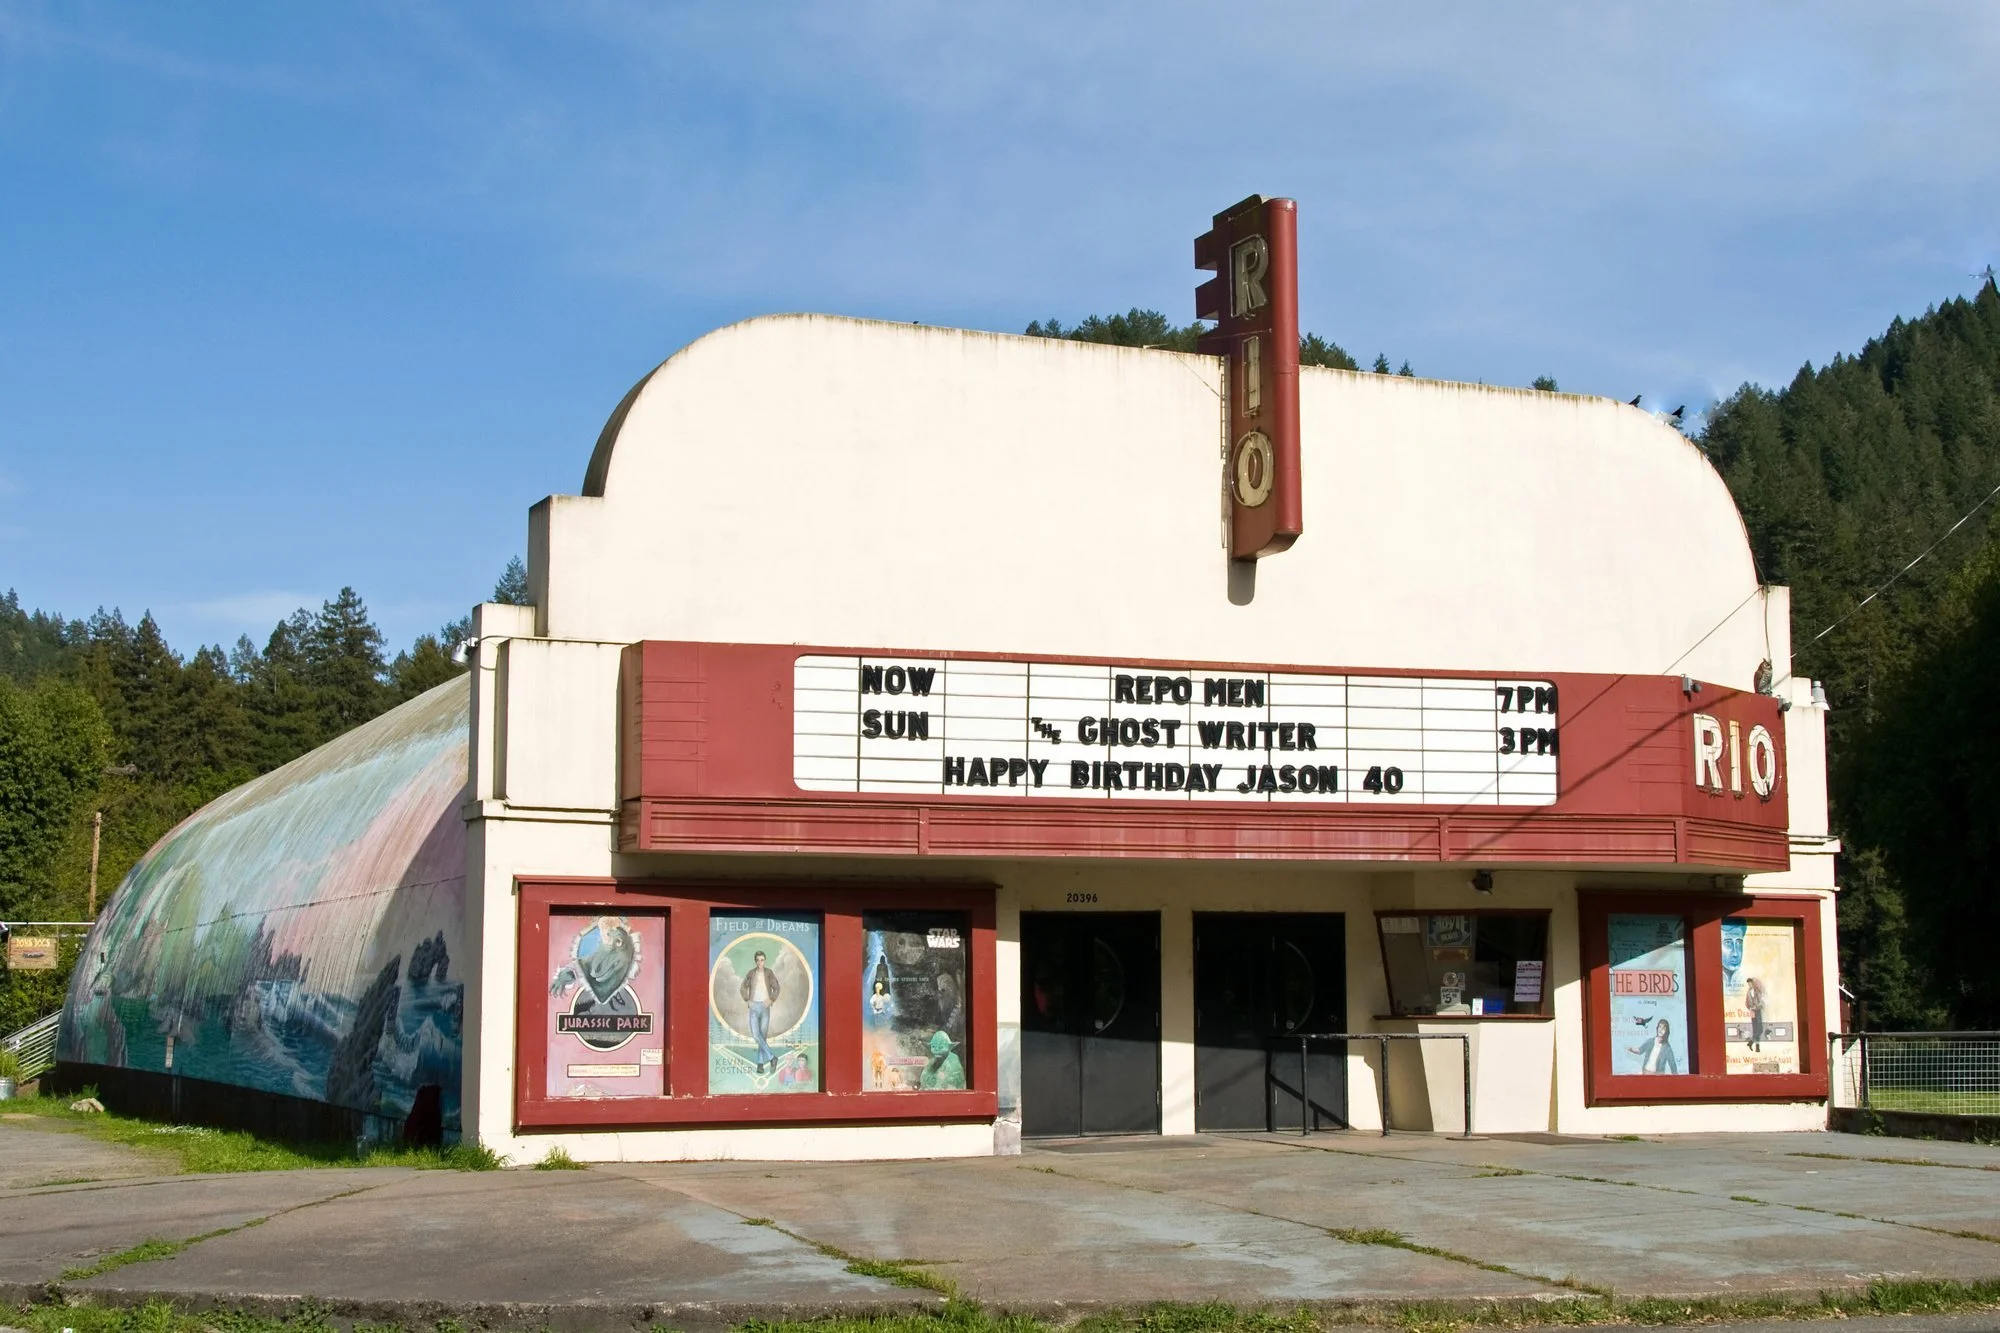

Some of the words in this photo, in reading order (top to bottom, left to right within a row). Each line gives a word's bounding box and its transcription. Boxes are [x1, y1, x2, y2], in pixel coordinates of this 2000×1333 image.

[1228, 233, 1275, 508] RIO
[861, 665, 936, 697] NOW
[1115, 675, 1192, 705] REPO
[1203, 677, 1265, 708] MEN
[1497, 686, 1556, 715] 7PM
[861, 709, 929, 742] SUN
[1031, 716, 1062, 745] THE
[1077, 716, 1181, 749] GHOST
[1198, 720, 1318, 751] WRITER
[1692, 713, 1780, 800] RIO
[944, 756, 1050, 788] HAPPY
[1070, 760, 1223, 793] BIRTHDAY
[1236, 764, 1339, 795] JASON
[1362, 766, 1404, 795] 40
[1066, 893, 1098, 903] 20396
[715, 917, 749, 932] FIELD
[767, 918, 810, 932] DREAMS
[928, 928, 960, 939] STAR
[926, 935, 961, 948] WARS
[1608, 973, 1633, 993] THE
[1638, 973, 1680, 993] BIRDS
[562, 1017, 611, 1031] JURASSIC
[616, 1017, 648, 1031] PARK
[715, 1058, 744, 1066] KEVIN
[714, 1066, 753, 1074] COSTNER
